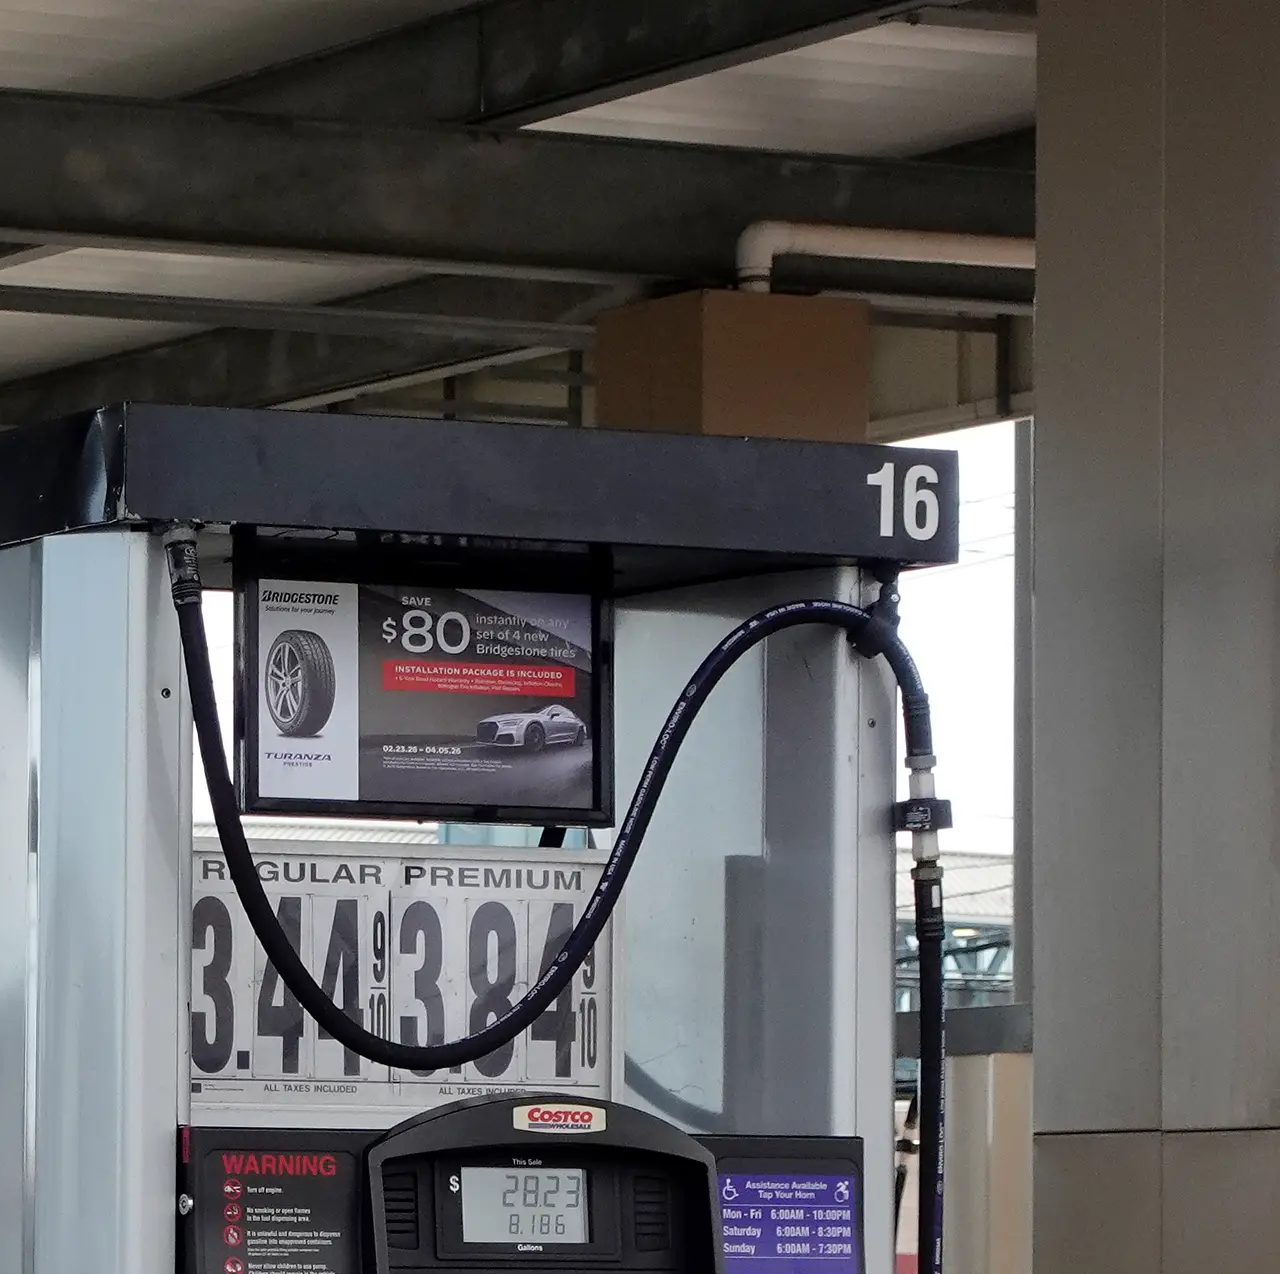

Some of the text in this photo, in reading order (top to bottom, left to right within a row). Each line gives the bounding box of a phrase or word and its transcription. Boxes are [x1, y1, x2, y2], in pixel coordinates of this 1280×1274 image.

[866, 462, 940, 541] 16
[261, 590, 339, 605] BRIDGESTONE
[401, 596, 431, 606] SAVE
[265, 605, 290, 613] Solutions
[476, 613, 527, 628] instantly
[545, 617, 570, 630] any
[382, 610, 471, 654] $80
[476, 629, 550, 642] set of 4 new
[476, 643, 576, 658] Bridgestone tires
[395, 665, 563, 679] INSTALLATION PACKAGE IS INCLUDED
[383, 745, 461, 755] 02.23.26 04.05.26
[265, 752, 333, 761] TURANZA
[202, 859, 583, 891] RGULAR PREMIUM
[264, 1084, 482, 1095] ALL TAXES INCLUDED ALL TAXES
[528, 1108, 593, 1123] COSTCO
[222, 1154, 337, 1176] WARNING
[512, 1158, 542, 1166] This Sale
[449, 1175, 581, 1208] $ 28.23
[745, 1181, 828, 1190] Assistance Available
[758, 1191, 815, 1200] Tap Your Horn
[722, 1209, 851, 1221] Mon Fri 6:00AM 10:00PM
[509, 1213, 566, 1235] 8.186
[723, 1226, 851, 1238] Saturday 6:00AM 8:30PM
[517, 1243, 543, 1252] Gallons
[723, 1243, 851, 1255] Sunday 6:00AM 7:30PM
